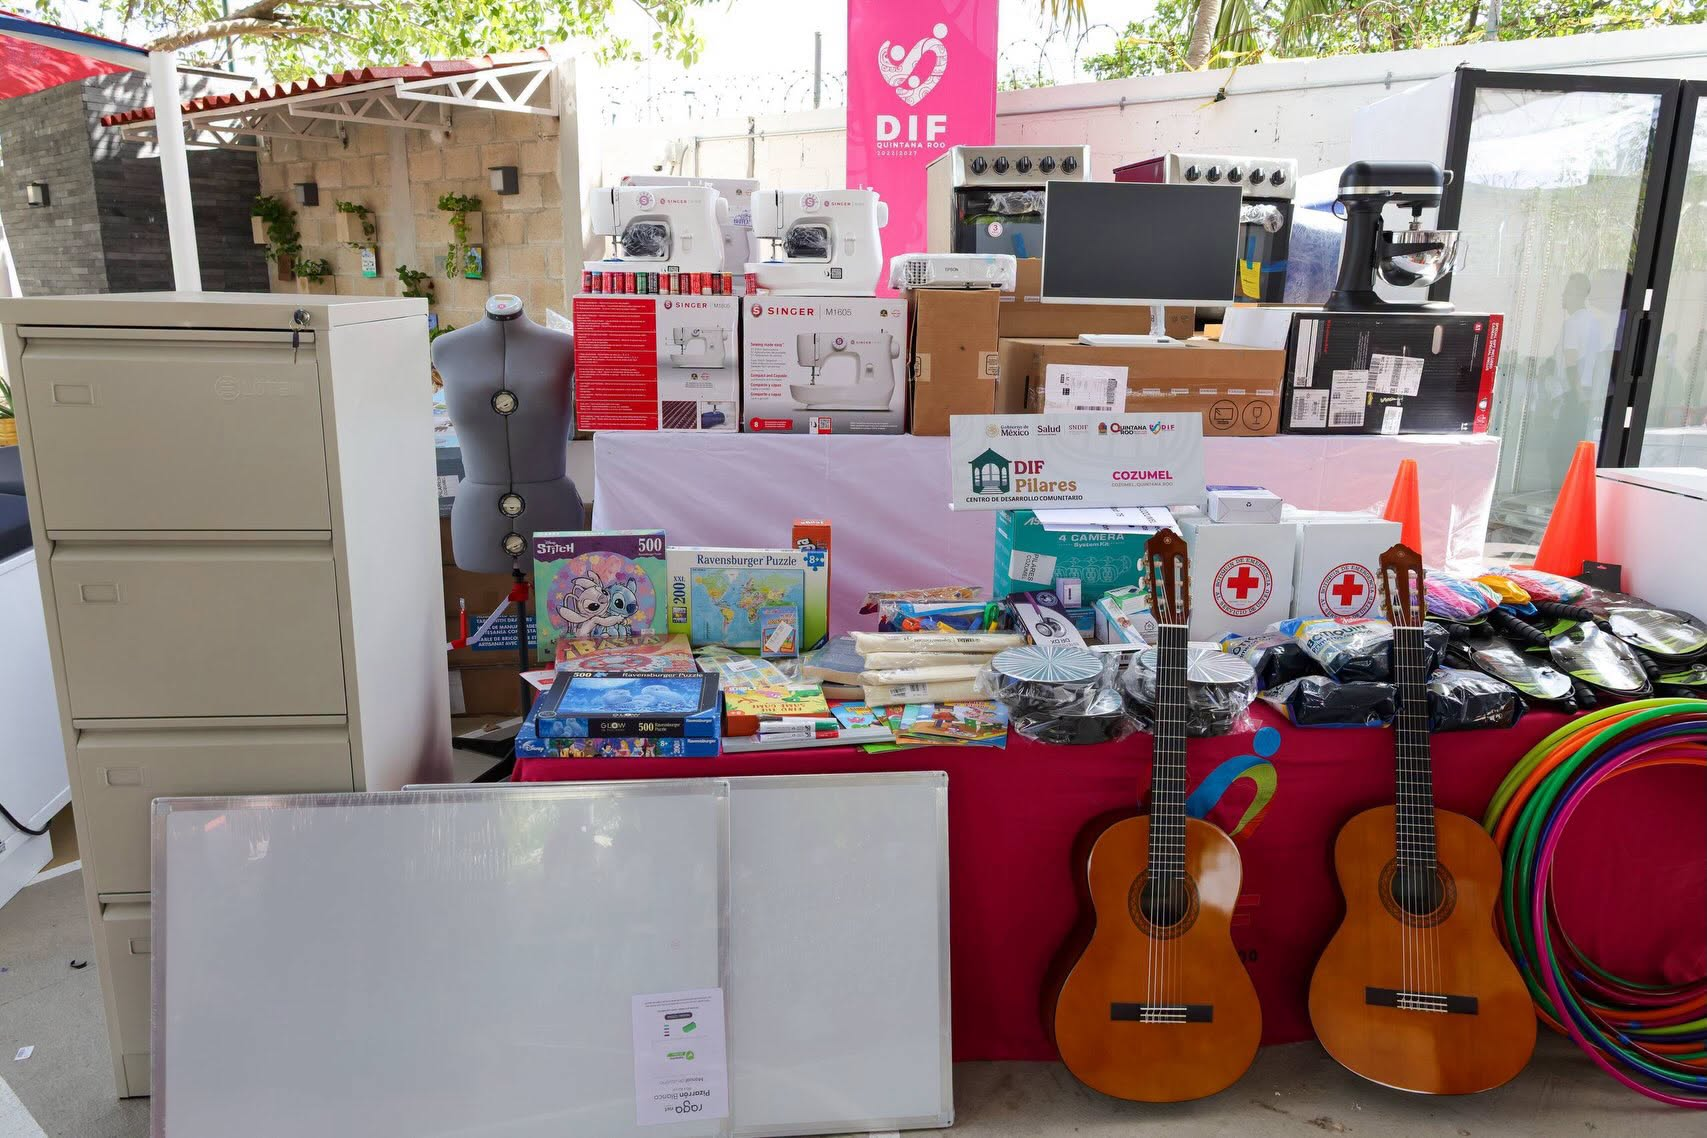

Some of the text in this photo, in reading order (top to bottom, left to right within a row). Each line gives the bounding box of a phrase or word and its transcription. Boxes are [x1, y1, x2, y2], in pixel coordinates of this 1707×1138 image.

[876, 115, 946, 141] DIF
[768, 307, 814, 316] SINGER
[825, 308, 852, 316] M1605
[1037, 425, 1061, 433] Salud
[1110, 423, 1147, 432] QUINTANA
[1014, 460, 1044, 474] DIF
[1112, 471, 1173, 480] COZUMEL
[1016, 478, 1077, 492] Pilares
[1072, 533, 1125, 541] CAMERA
[638, 538, 662, 552] 500
[697, 554, 797, 567] Ravensburger Puzzle
[1022, 554, 1032, 580] COZUMEL
[1028, 554, 1039, 581] PILARES
[673, 582, 686, 604] 200
[638, 723, 654, 732] 500
[679, 1090, 710, 1098] Pizarrón
[675, 1100, 703, 1114] raga
